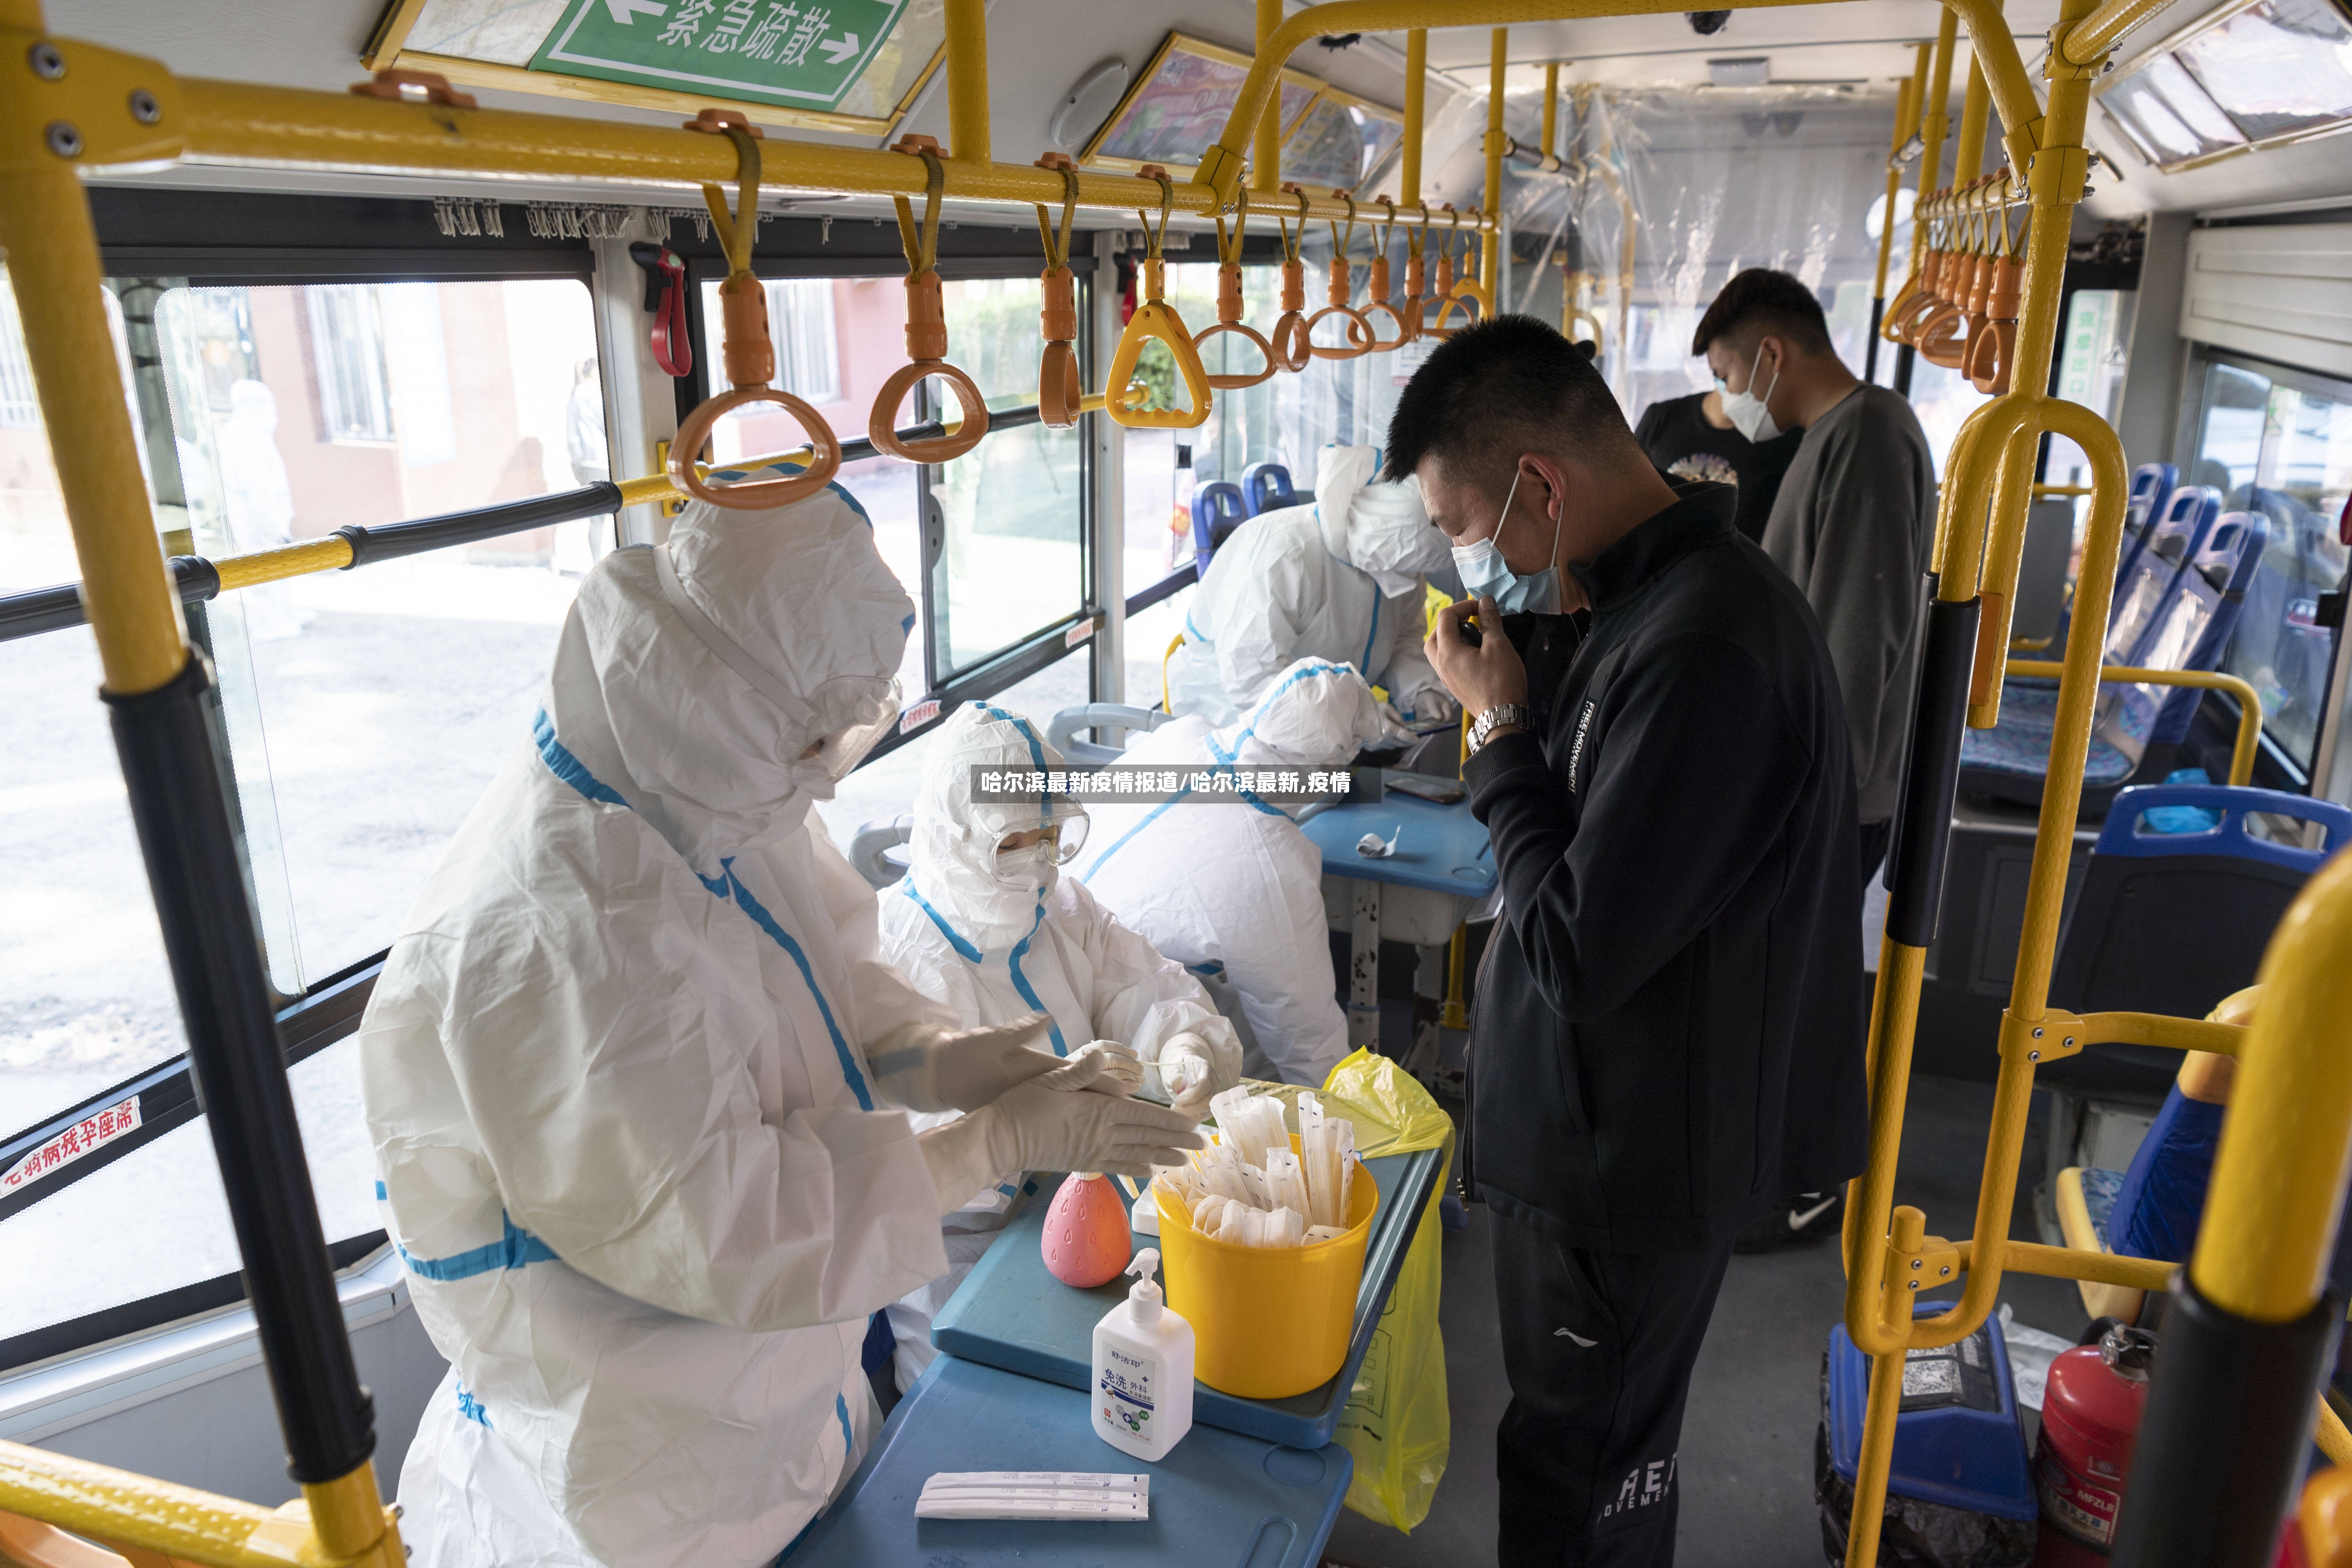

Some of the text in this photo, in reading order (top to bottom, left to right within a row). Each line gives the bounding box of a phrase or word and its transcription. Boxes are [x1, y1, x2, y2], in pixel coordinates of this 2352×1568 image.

[657, 0, 832, 67] 紧急疏散
[1571, 731, 1585, 795] MOVEMENT
[1105, 1369, 1147, 1394] 免洗 外科
[1596, 1483, 1670, 1524] OVEMEN
